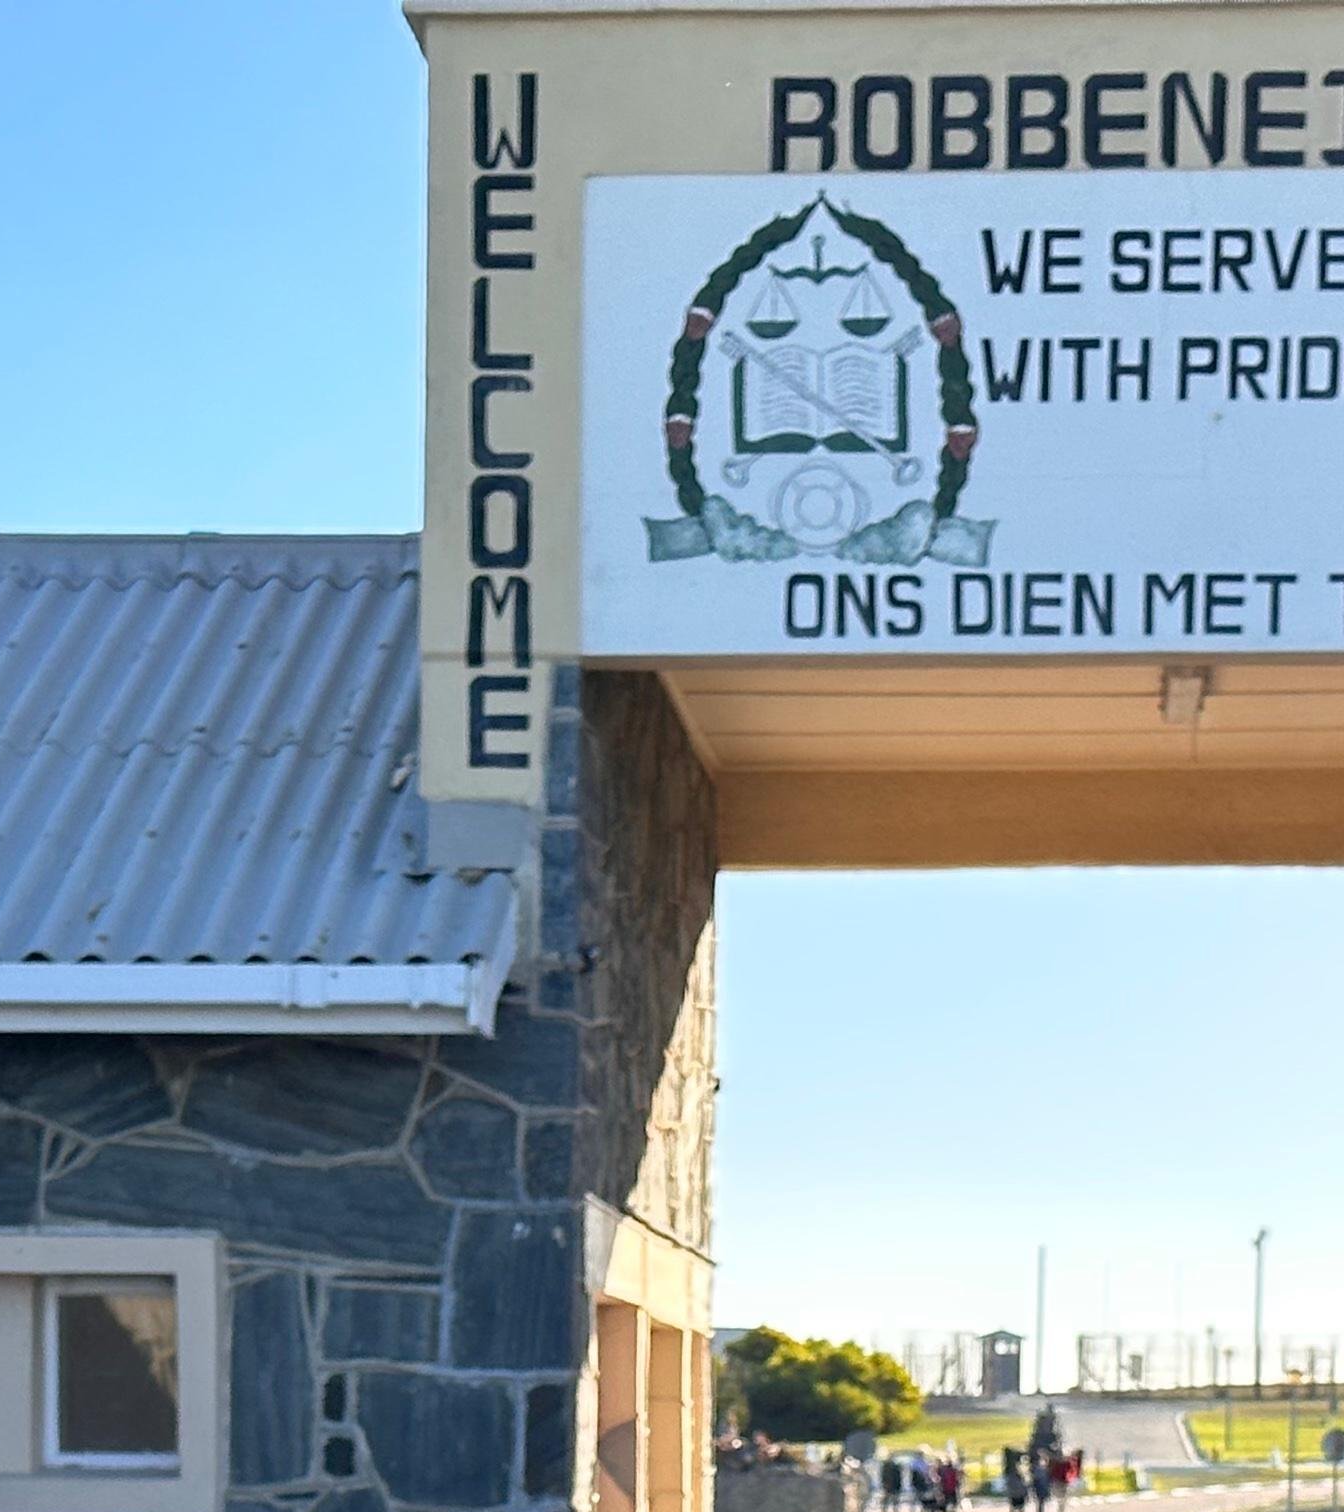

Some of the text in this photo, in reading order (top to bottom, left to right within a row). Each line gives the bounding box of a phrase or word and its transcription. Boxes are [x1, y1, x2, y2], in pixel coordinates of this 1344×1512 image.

[982, 229, 1082, 294] WE
[982, 337, 1151, 402] WITH
[465, 73, 539, 768] WELCOME
[785, 573, 923, 638] ONS
[952, 573, 1114, 636] DIEN
[1144, 573, 1297, 636] MET
